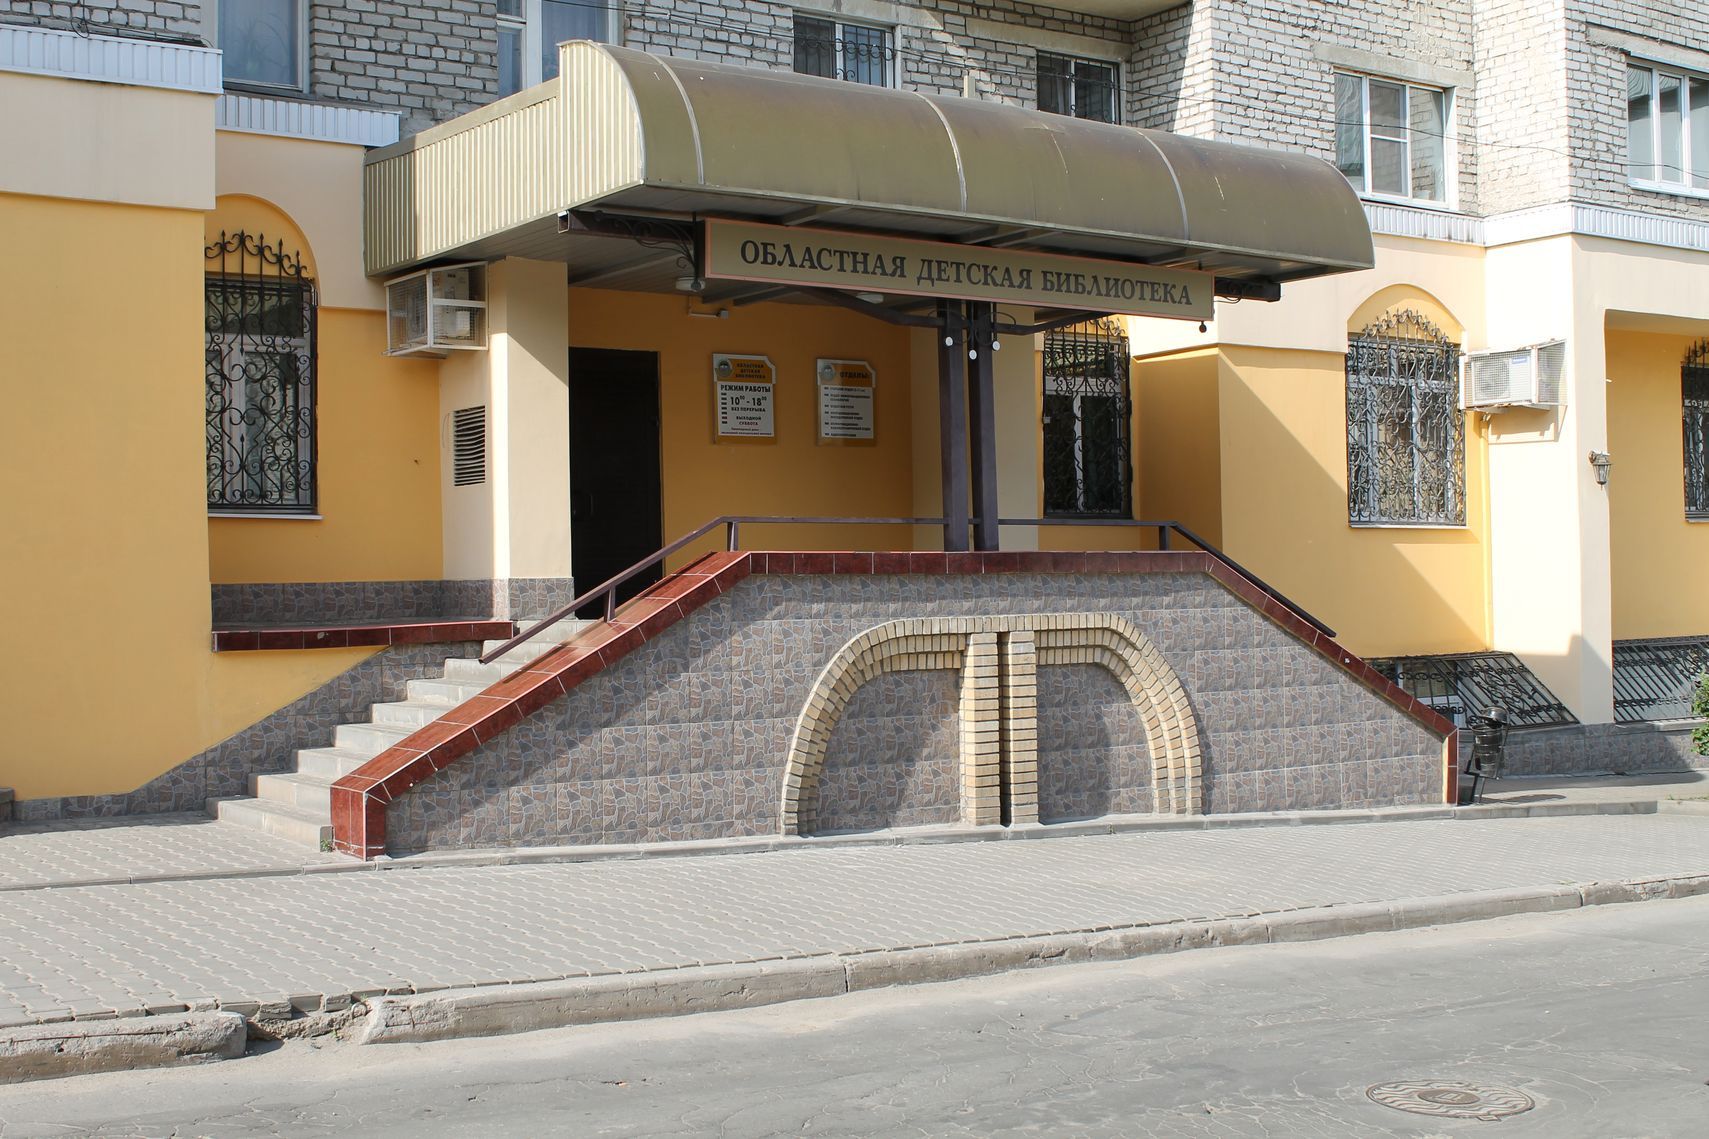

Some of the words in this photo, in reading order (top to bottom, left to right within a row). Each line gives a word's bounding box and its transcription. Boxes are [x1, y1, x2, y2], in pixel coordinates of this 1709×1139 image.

[740, 240, 907, 278] ОБЛАСТНАЯ
[916, 259, 1033, 290] ДЕТСКАЯ
[1040, 270, 1193, 306] БИБЛИОТЕКА
